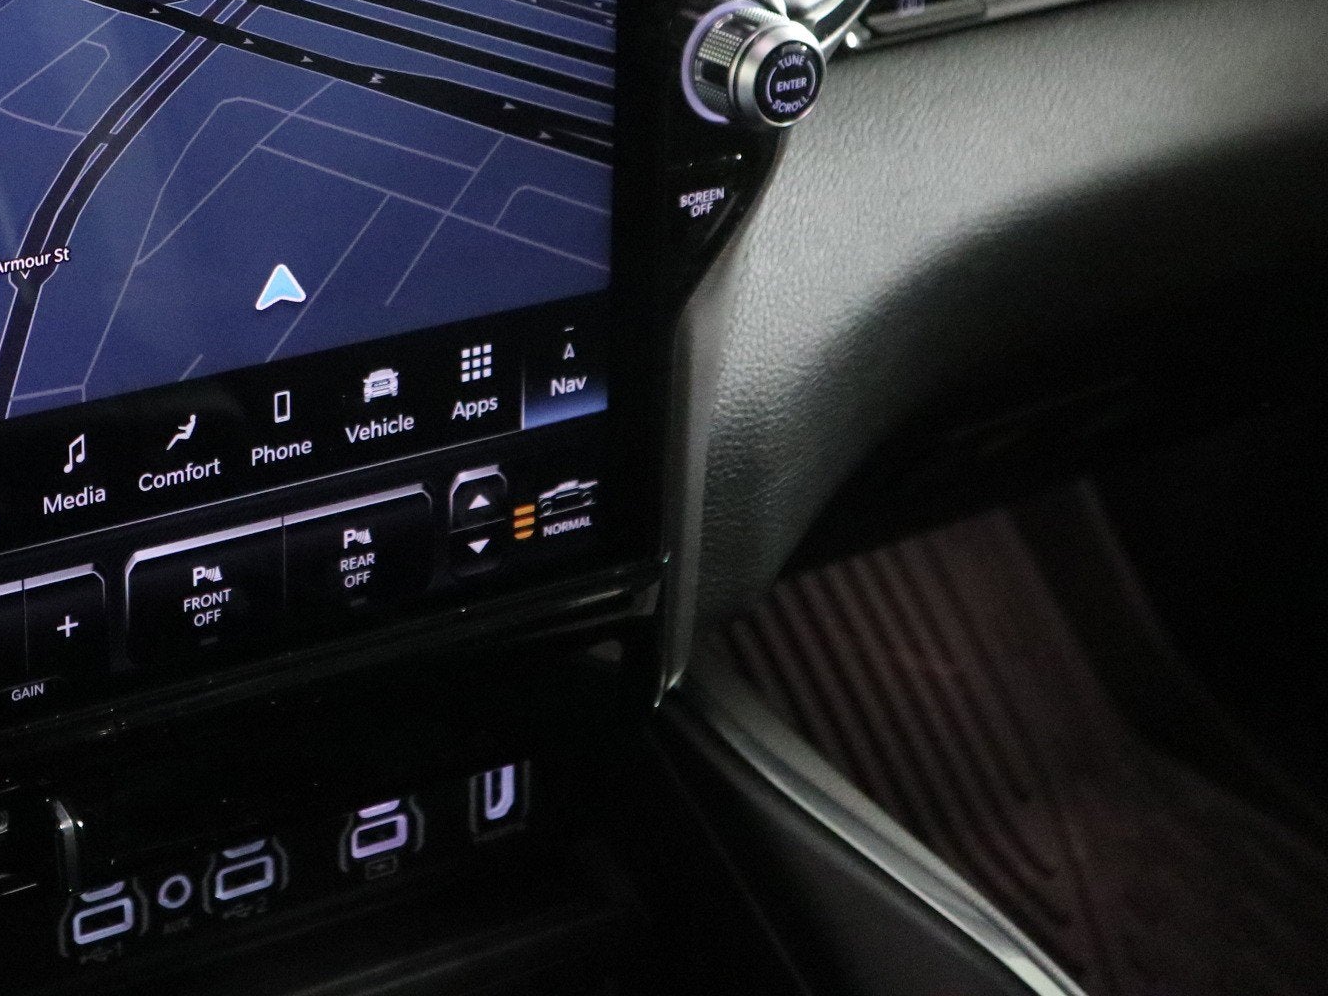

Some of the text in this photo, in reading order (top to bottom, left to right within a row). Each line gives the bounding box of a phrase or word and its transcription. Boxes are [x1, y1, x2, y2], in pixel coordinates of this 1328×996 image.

[778, 54, 805, 69] TUNE
[776, 77, 807, 92] ENTER
[772, 96, 809, 114] SCROLL
[679, 187, 725, 208] SCREEN
[690, 201, 714, 218] OFF
[54, 248, 70, 263] St
[550, 375, 588, 397] Nav
[452, 396, 499, 421] Apps
[345, 415, 415, 445] Vehicle
[251, 439, 313, 466] Phone
[138, 458, 221, 492] Comfort
[43, 485, 107, 515] Media
[543, 515, 593, 538] NORMAL
[340, 553, 375, 573] REAR
[344, 571, 372, 589] OFF
[183, 588, 232, 613] FRONT
[193, 609, 222, 628] OFF
[11, 682, 44, 702] GAIN
